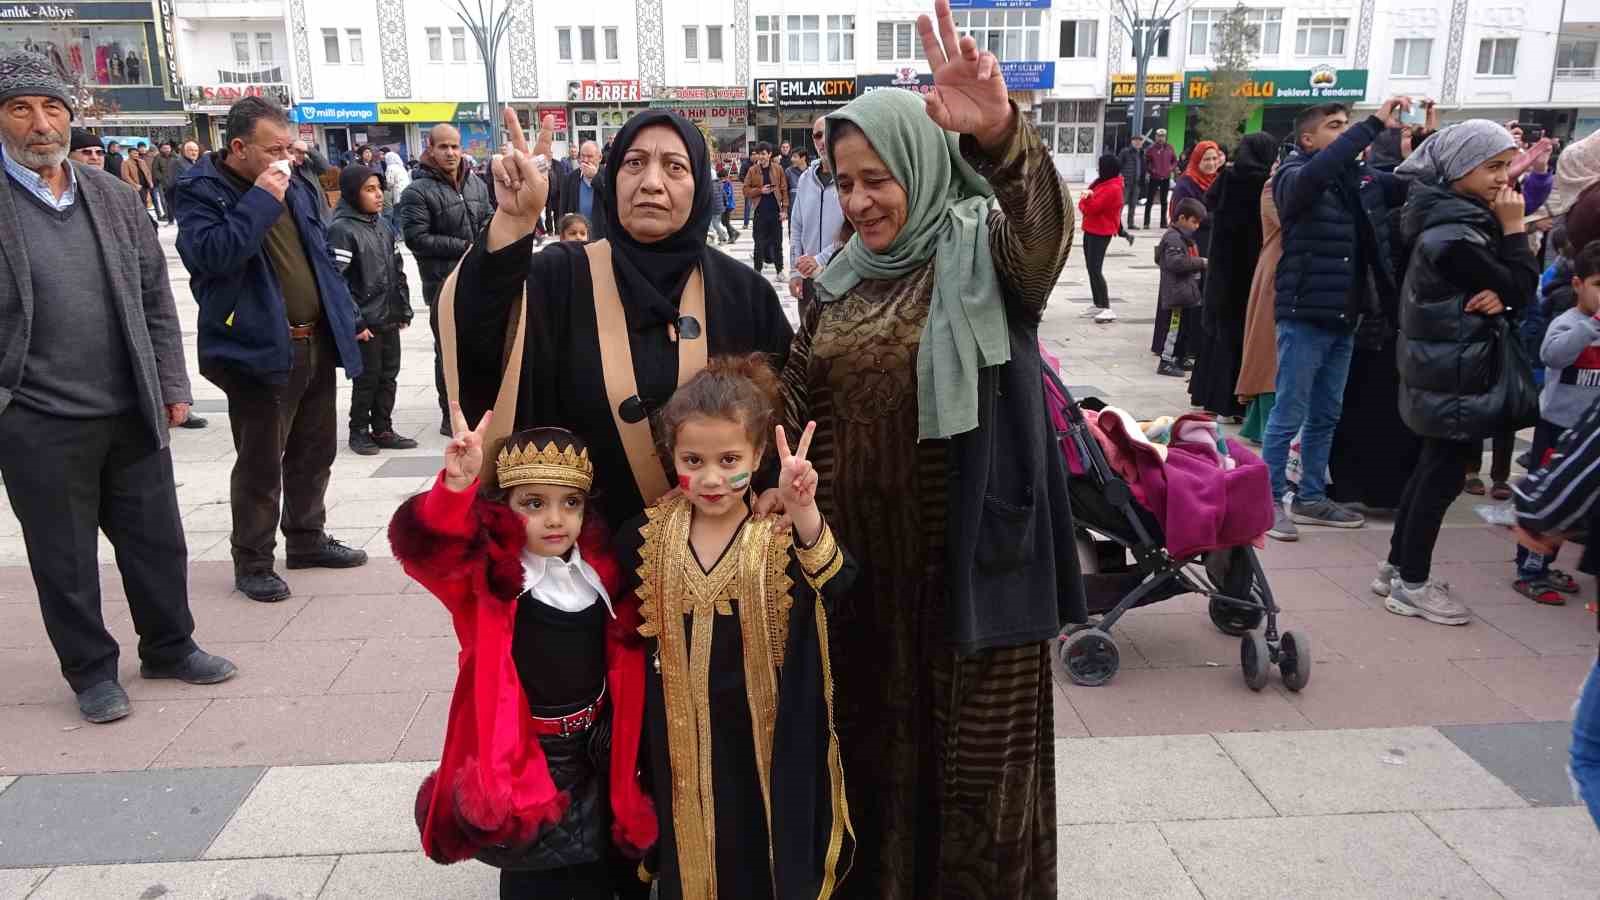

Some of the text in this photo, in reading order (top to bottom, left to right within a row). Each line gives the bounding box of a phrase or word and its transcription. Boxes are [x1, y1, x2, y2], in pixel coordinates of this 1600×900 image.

[0, 5, 31, 18] anlık
[584, 85, 638, 101] BERBER
[780, 80, 855, 96] EMLAKCITY
[1145, 83, 1170, 97] GSM
[316, 108, 373, 119] milli piyango
